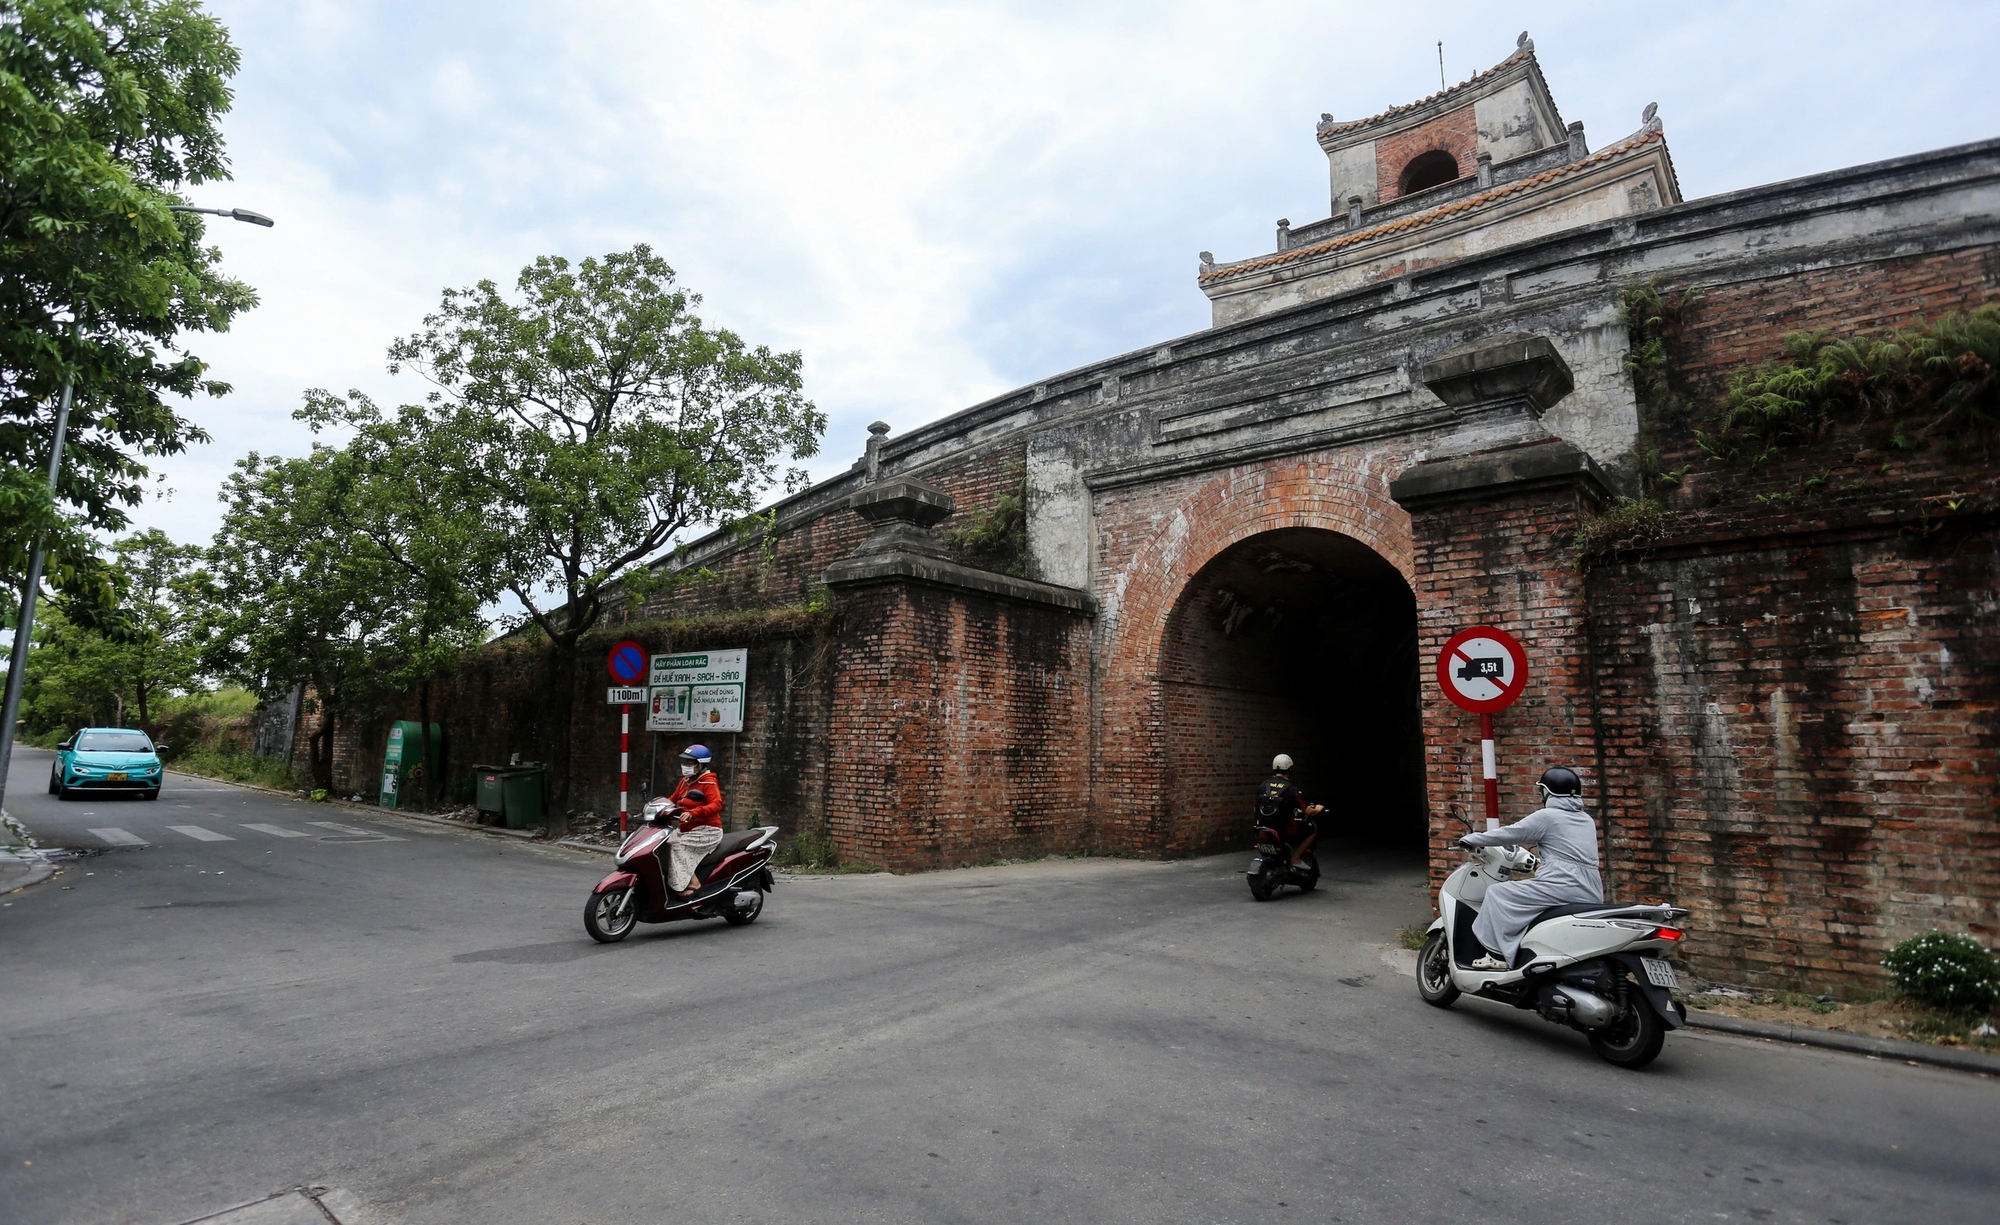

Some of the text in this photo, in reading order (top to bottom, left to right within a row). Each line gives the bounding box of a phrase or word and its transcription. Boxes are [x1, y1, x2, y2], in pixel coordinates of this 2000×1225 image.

[655, 657, 707, 668] HÃY PHÂN LOẠI RÁC
[1480, 662, 1497, 674] 3,5t
[662, 671, 674, 683] HUẾ
[674, 673, 691, 683] XANH
[697, 672, 715, 683] SẠCH
[721, 669, 740, 680] SÁNG
[616, 689, 640, 701] 100m
[709, 687, 719, 695] CHẾ
[716, 696, 727, 704] MỘT
